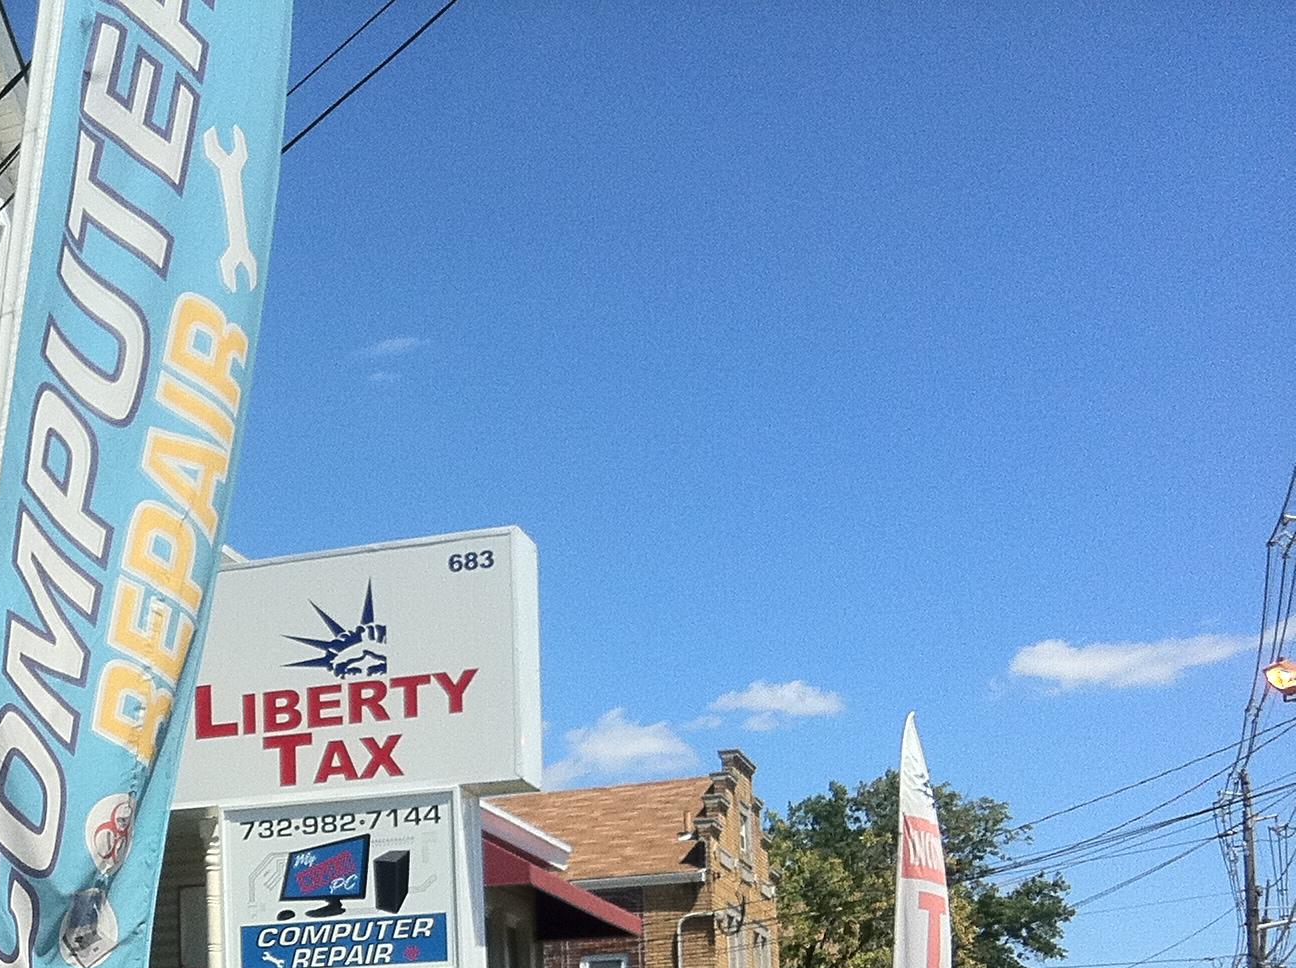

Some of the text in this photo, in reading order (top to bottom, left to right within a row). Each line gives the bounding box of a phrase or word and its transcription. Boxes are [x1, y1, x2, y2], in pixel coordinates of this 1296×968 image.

[92, 290, 249, 768] REPAIR
[448, 550, 495, 573] 683
[194, 667, 481, 741] LIBERTY
[262, 732, 405, 788] TAX
[292, 851, 317, 870] My
[328, 873, 359, 895] PC
[257, 916, 436, 949] COMPUTER
